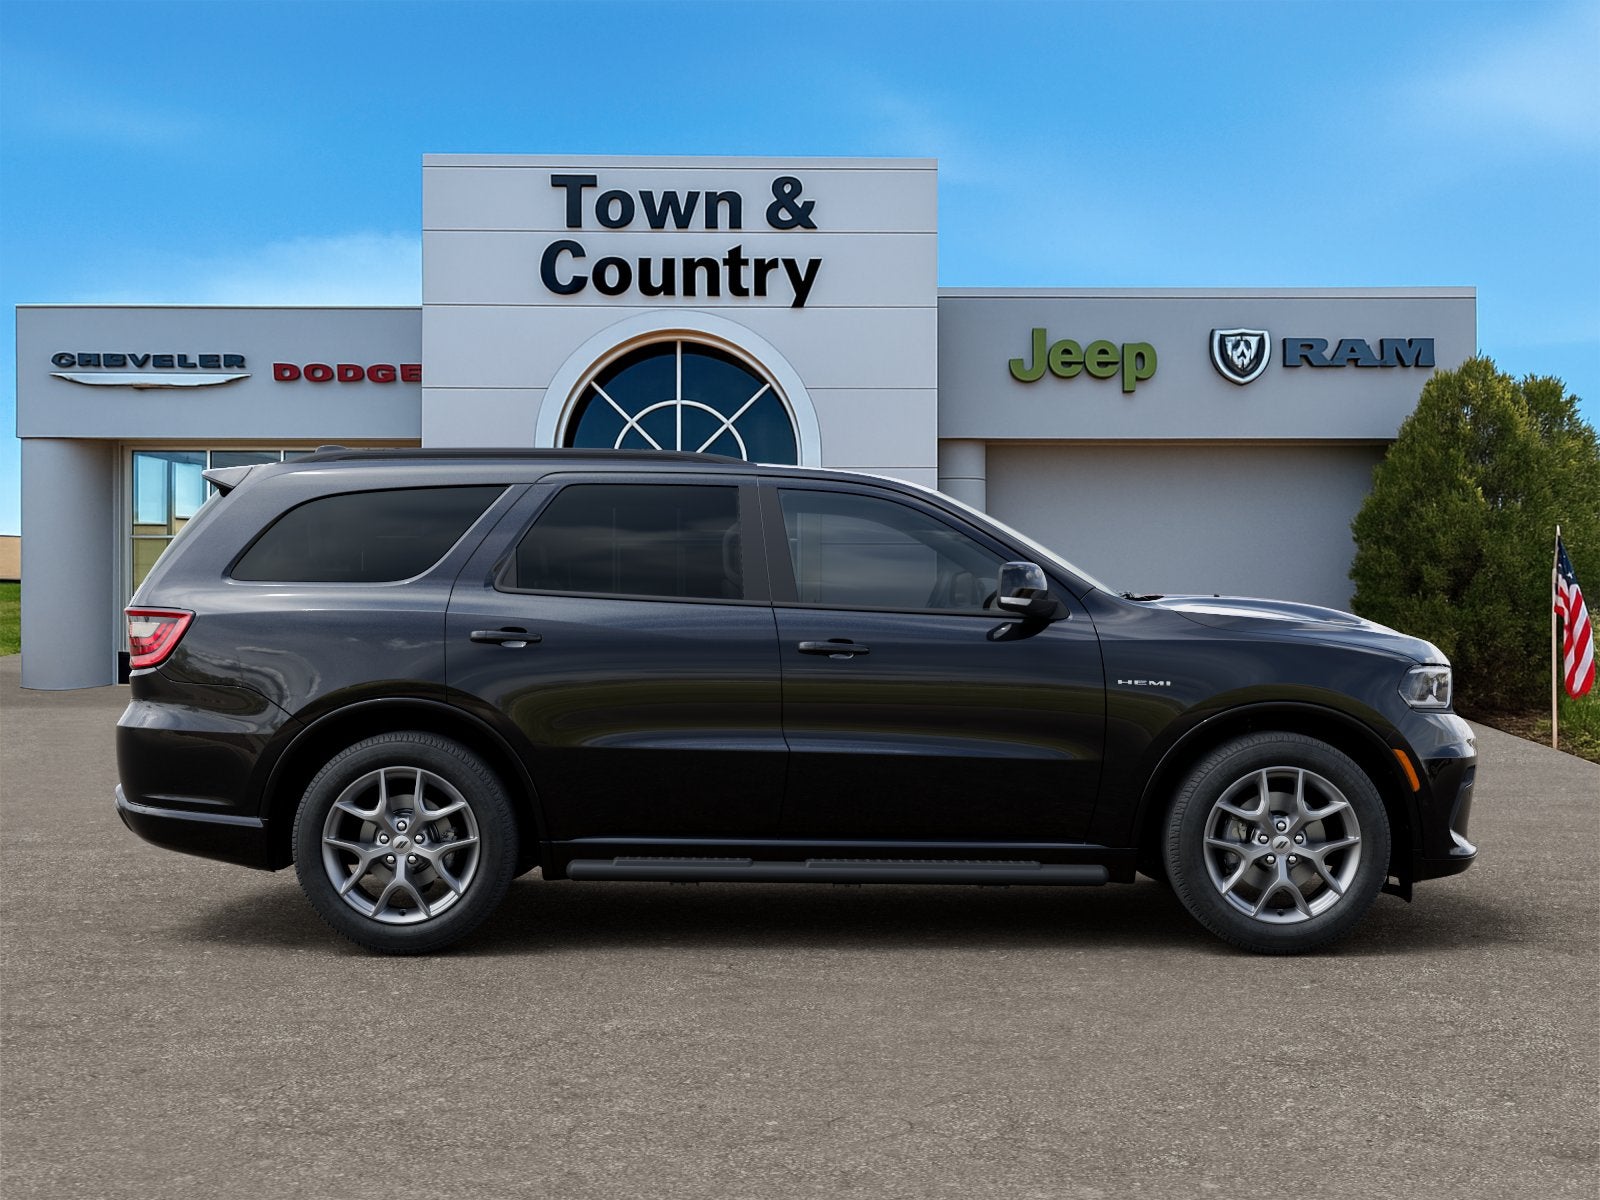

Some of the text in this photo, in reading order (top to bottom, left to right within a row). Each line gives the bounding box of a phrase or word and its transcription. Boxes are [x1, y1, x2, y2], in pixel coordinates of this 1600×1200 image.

[550, 173, 818, 230] Town &
[539, 239, 822, 308] Country
[272, 362, 422, 383] DODGE
[1008, 327, 1158, 393] Jeep
[1282, 336, 1436, 368] RAM
[1117, 679, 1172, 687] HEMI
